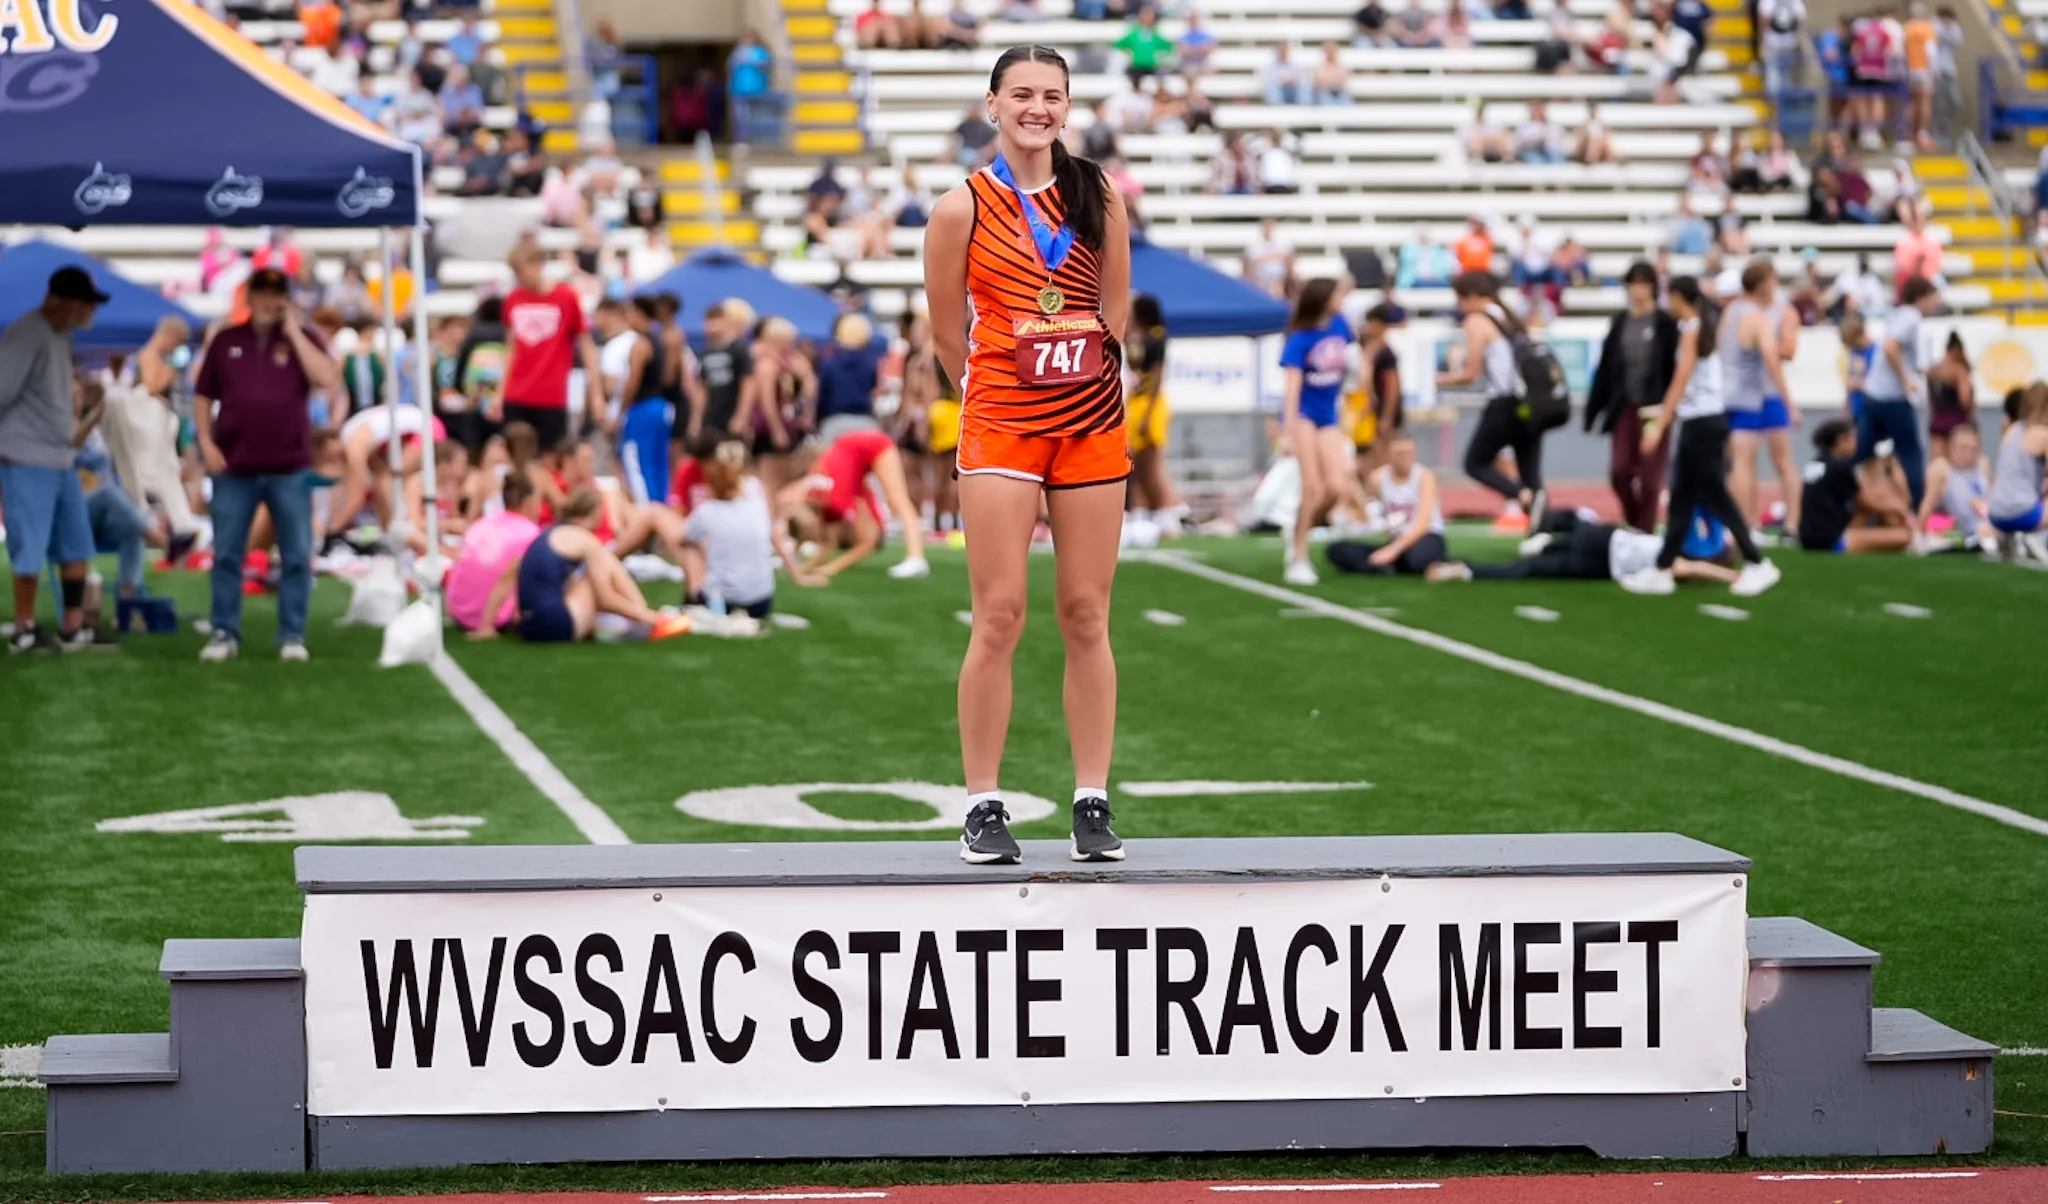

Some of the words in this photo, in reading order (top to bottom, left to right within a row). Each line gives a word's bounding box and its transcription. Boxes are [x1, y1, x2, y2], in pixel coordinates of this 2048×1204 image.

[1033, 338, 1087, 376] 747
[360, 931, 757, 1069] WVSSAC
[790, 928, 1066, 1062] STATE
[1096, 923, 1409, 1056] TRACK
[1438, 919, 1679, 1051] MEET
